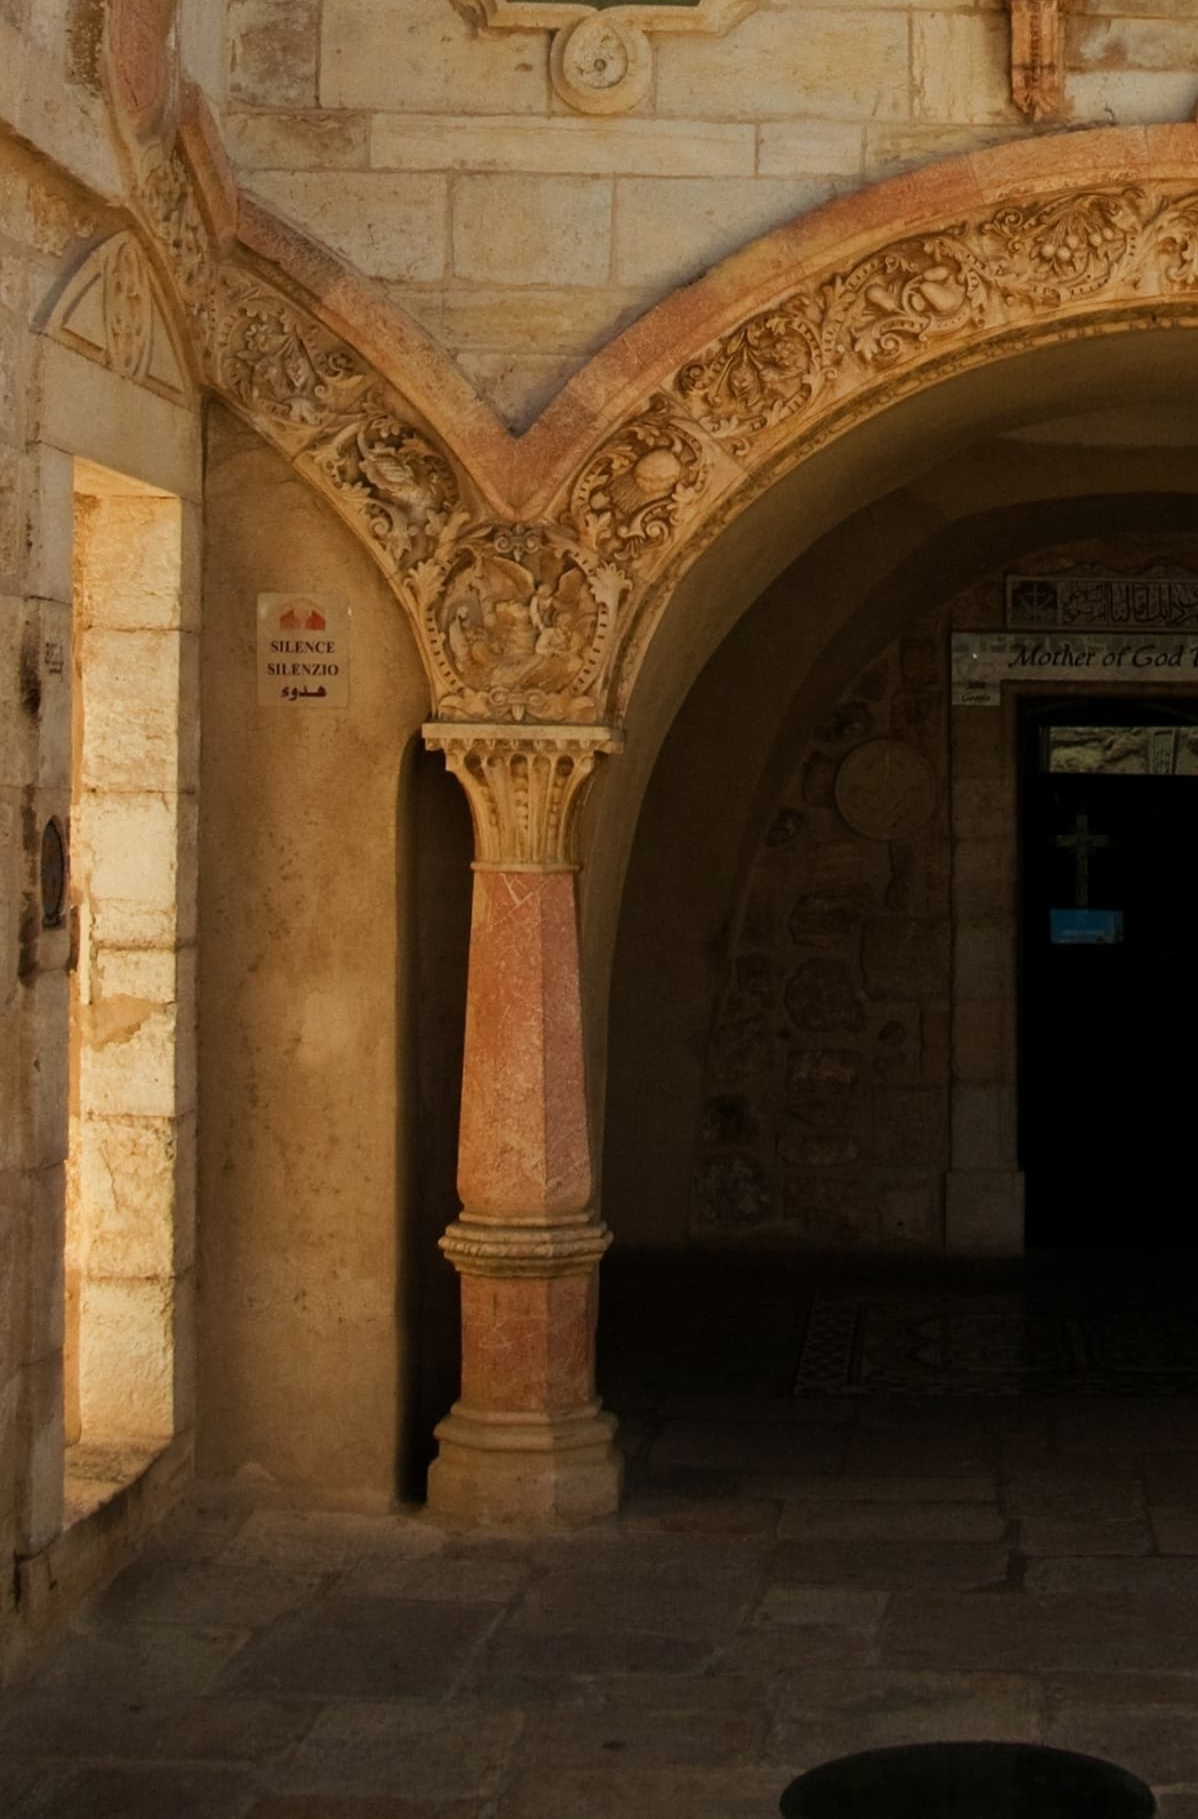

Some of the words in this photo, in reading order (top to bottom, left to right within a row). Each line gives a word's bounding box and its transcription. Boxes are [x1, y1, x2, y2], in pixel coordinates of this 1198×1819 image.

[271, 640, 336, 654] SILENCE
[1008, 644, 1095, 668] Mother
[1102, 644, 1130, 668] of
[1131, 644, 1186, 668] God
[267, 663, 339, 676] SILENZIO
